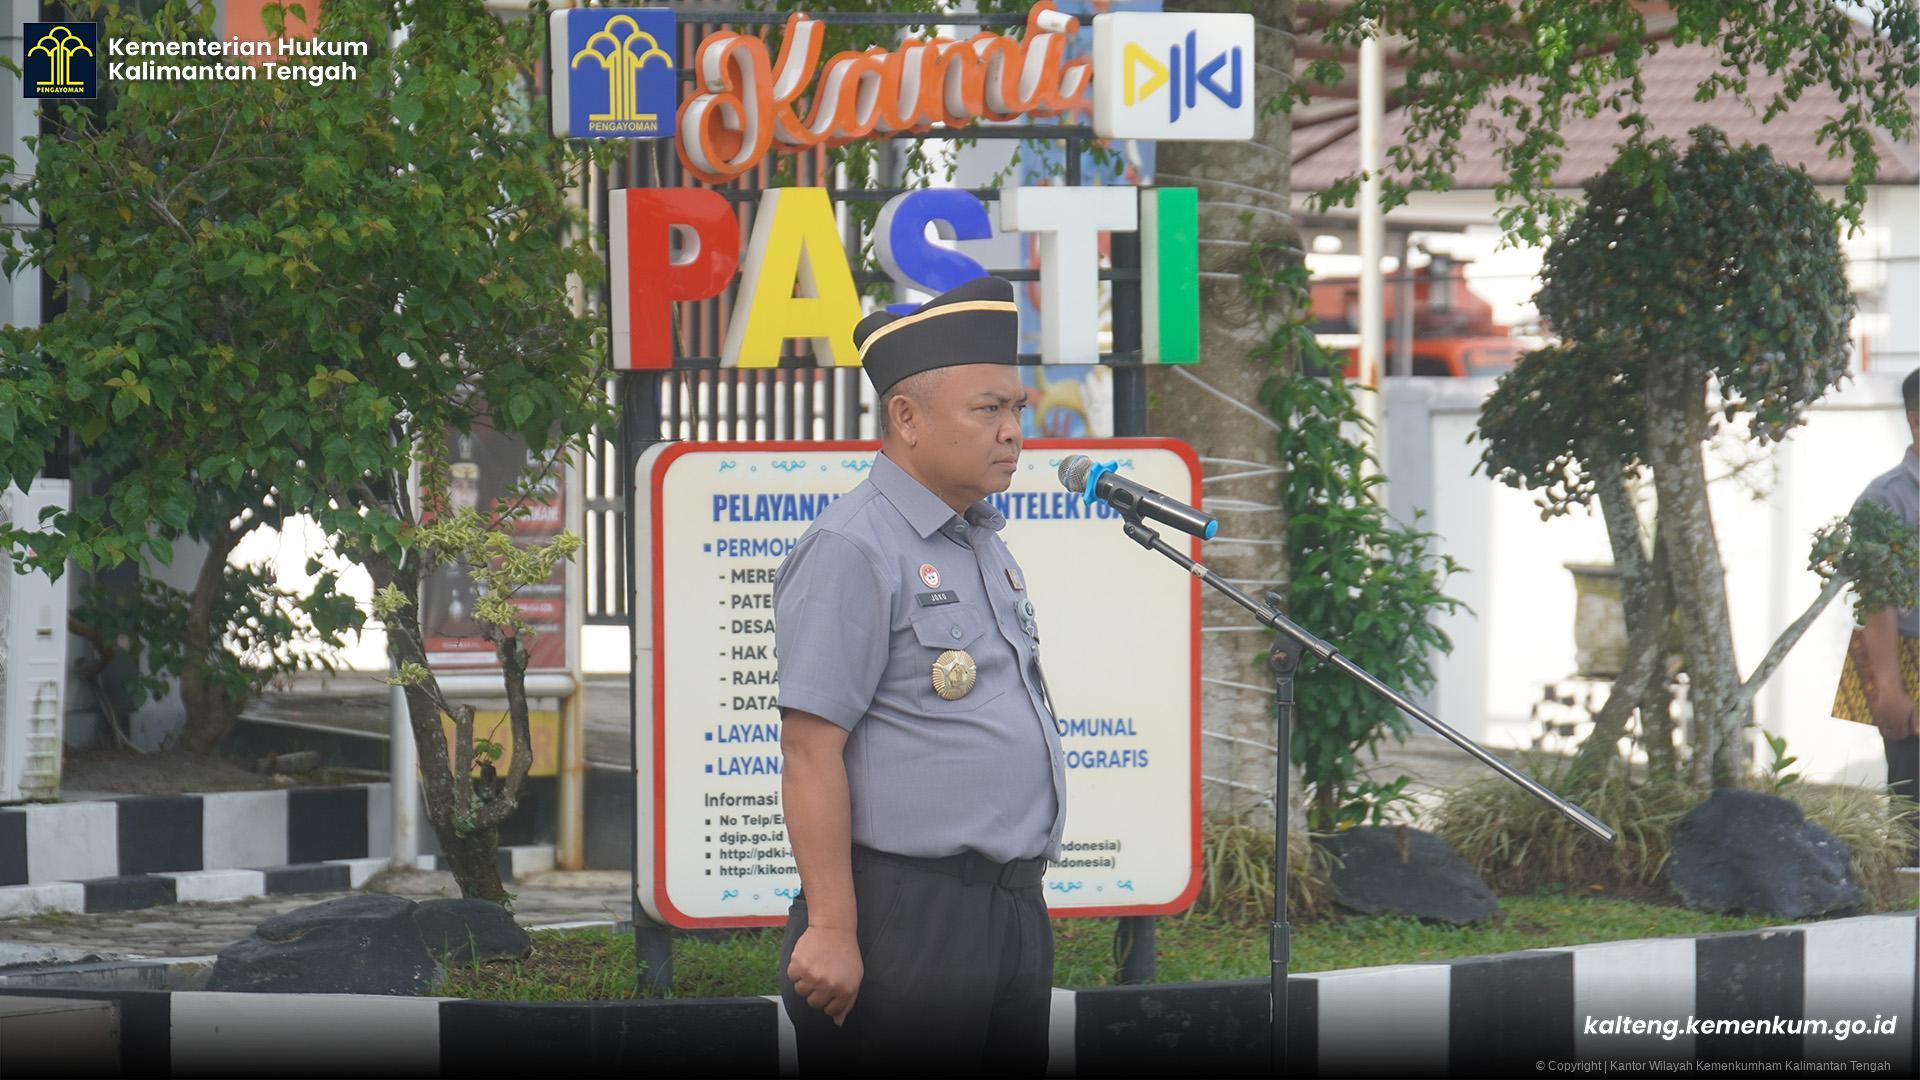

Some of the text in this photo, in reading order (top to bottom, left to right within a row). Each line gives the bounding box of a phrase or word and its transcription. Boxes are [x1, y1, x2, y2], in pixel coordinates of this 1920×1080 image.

[676, 1, 1093, 184] Kami
[588, 121, 658, 132] PENGAYOMAN
[610, 186, 1200, 369] PASTI
[713, 494, 847, 521] PELAYANA
[731, 568, 777, 583] MERE
[731, 594, 773, 608] PATE
[732, 619, 776, 634] DESA
[732, 645, 767, 660] HAK
[733, 670, 779, 685] RAHA
[733, 696, 779, 710] DATA
[1062, 749, 1149, 769] OGRAFIS
[705, 791, 778, 807] Informasi
[720, 814, 785, 827] No Telp/E
[720, 831, 783, 845] dgip.go.id
